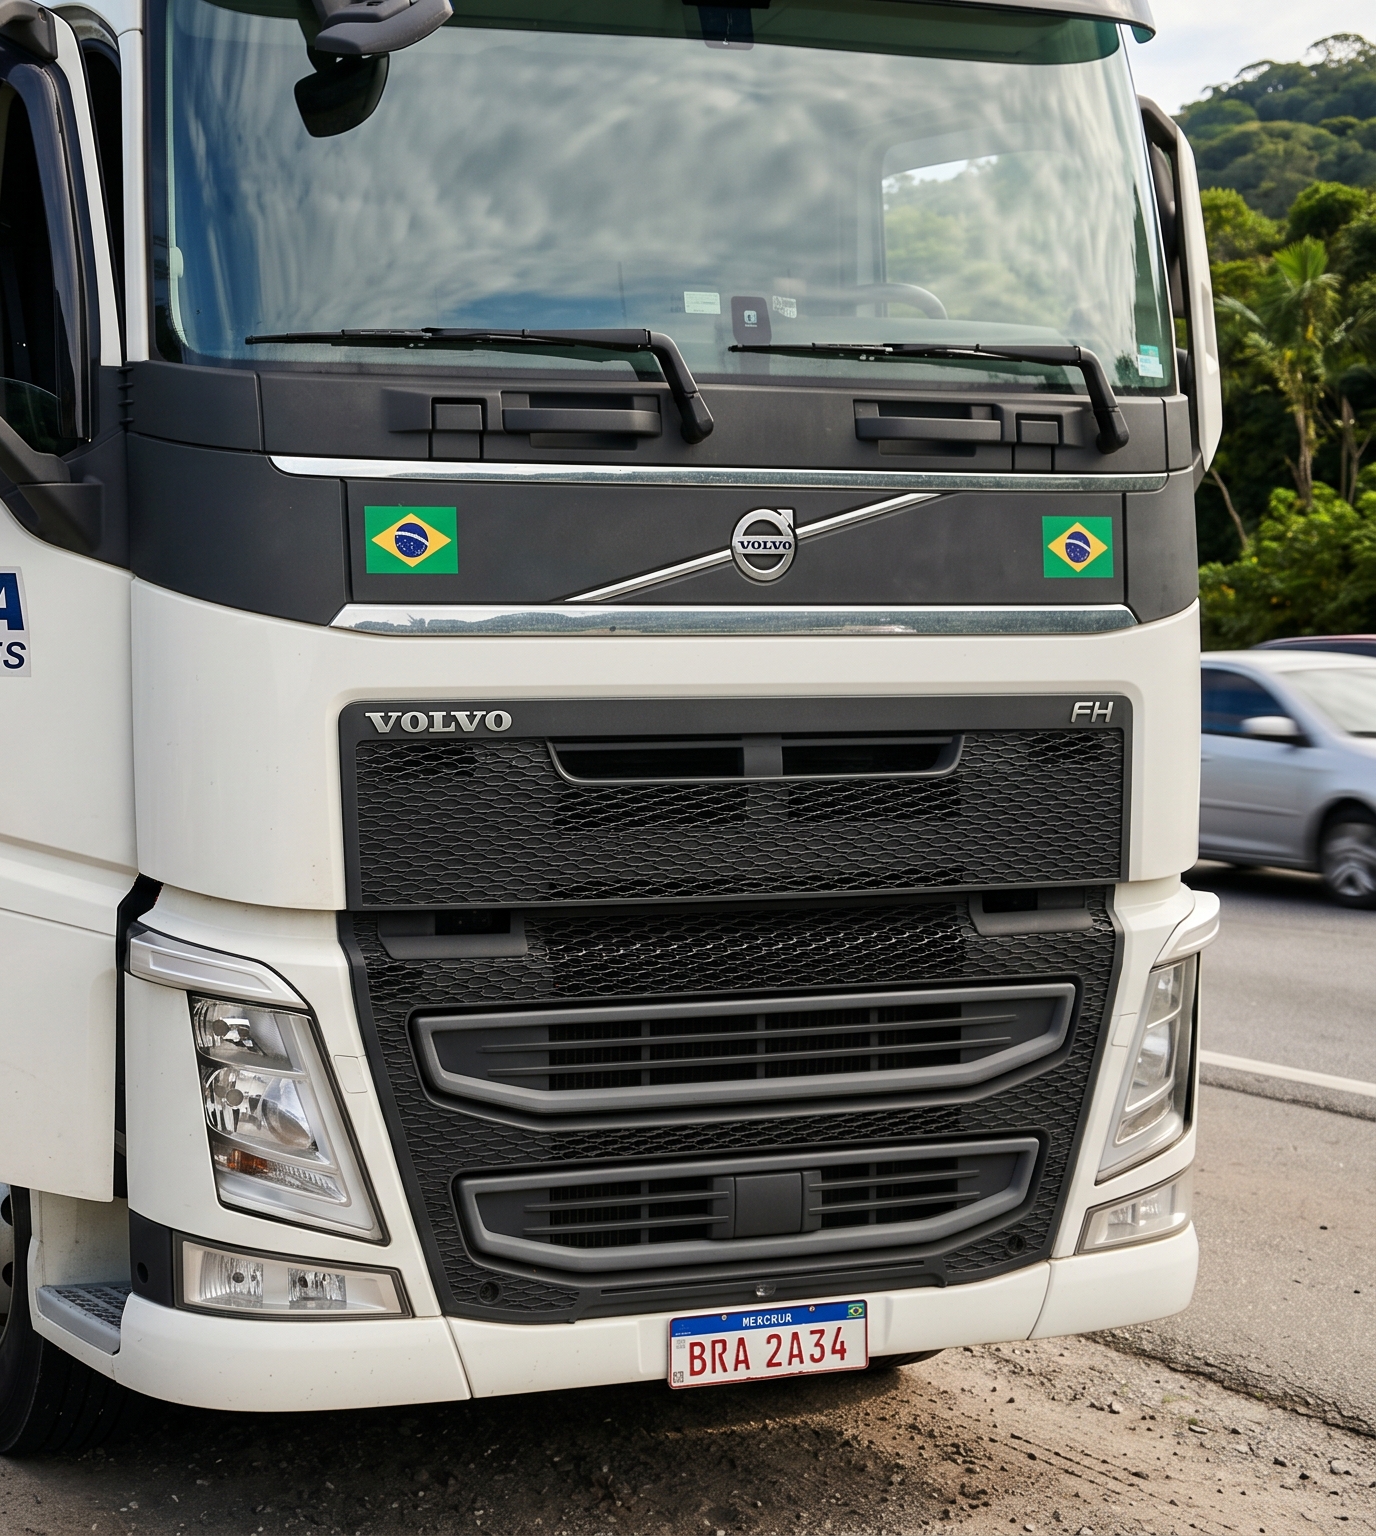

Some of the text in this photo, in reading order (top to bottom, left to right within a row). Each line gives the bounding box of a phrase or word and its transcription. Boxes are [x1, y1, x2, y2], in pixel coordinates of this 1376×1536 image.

[737, 540, 792, 550] VOLVO
[364, 710, 513, 733] VOLVO
[1070, 701, 1114, 723] FH
[742, 1313, 793, 1327] MERCRUR
[689, 1326, 847, 1377] BRA 2A34
